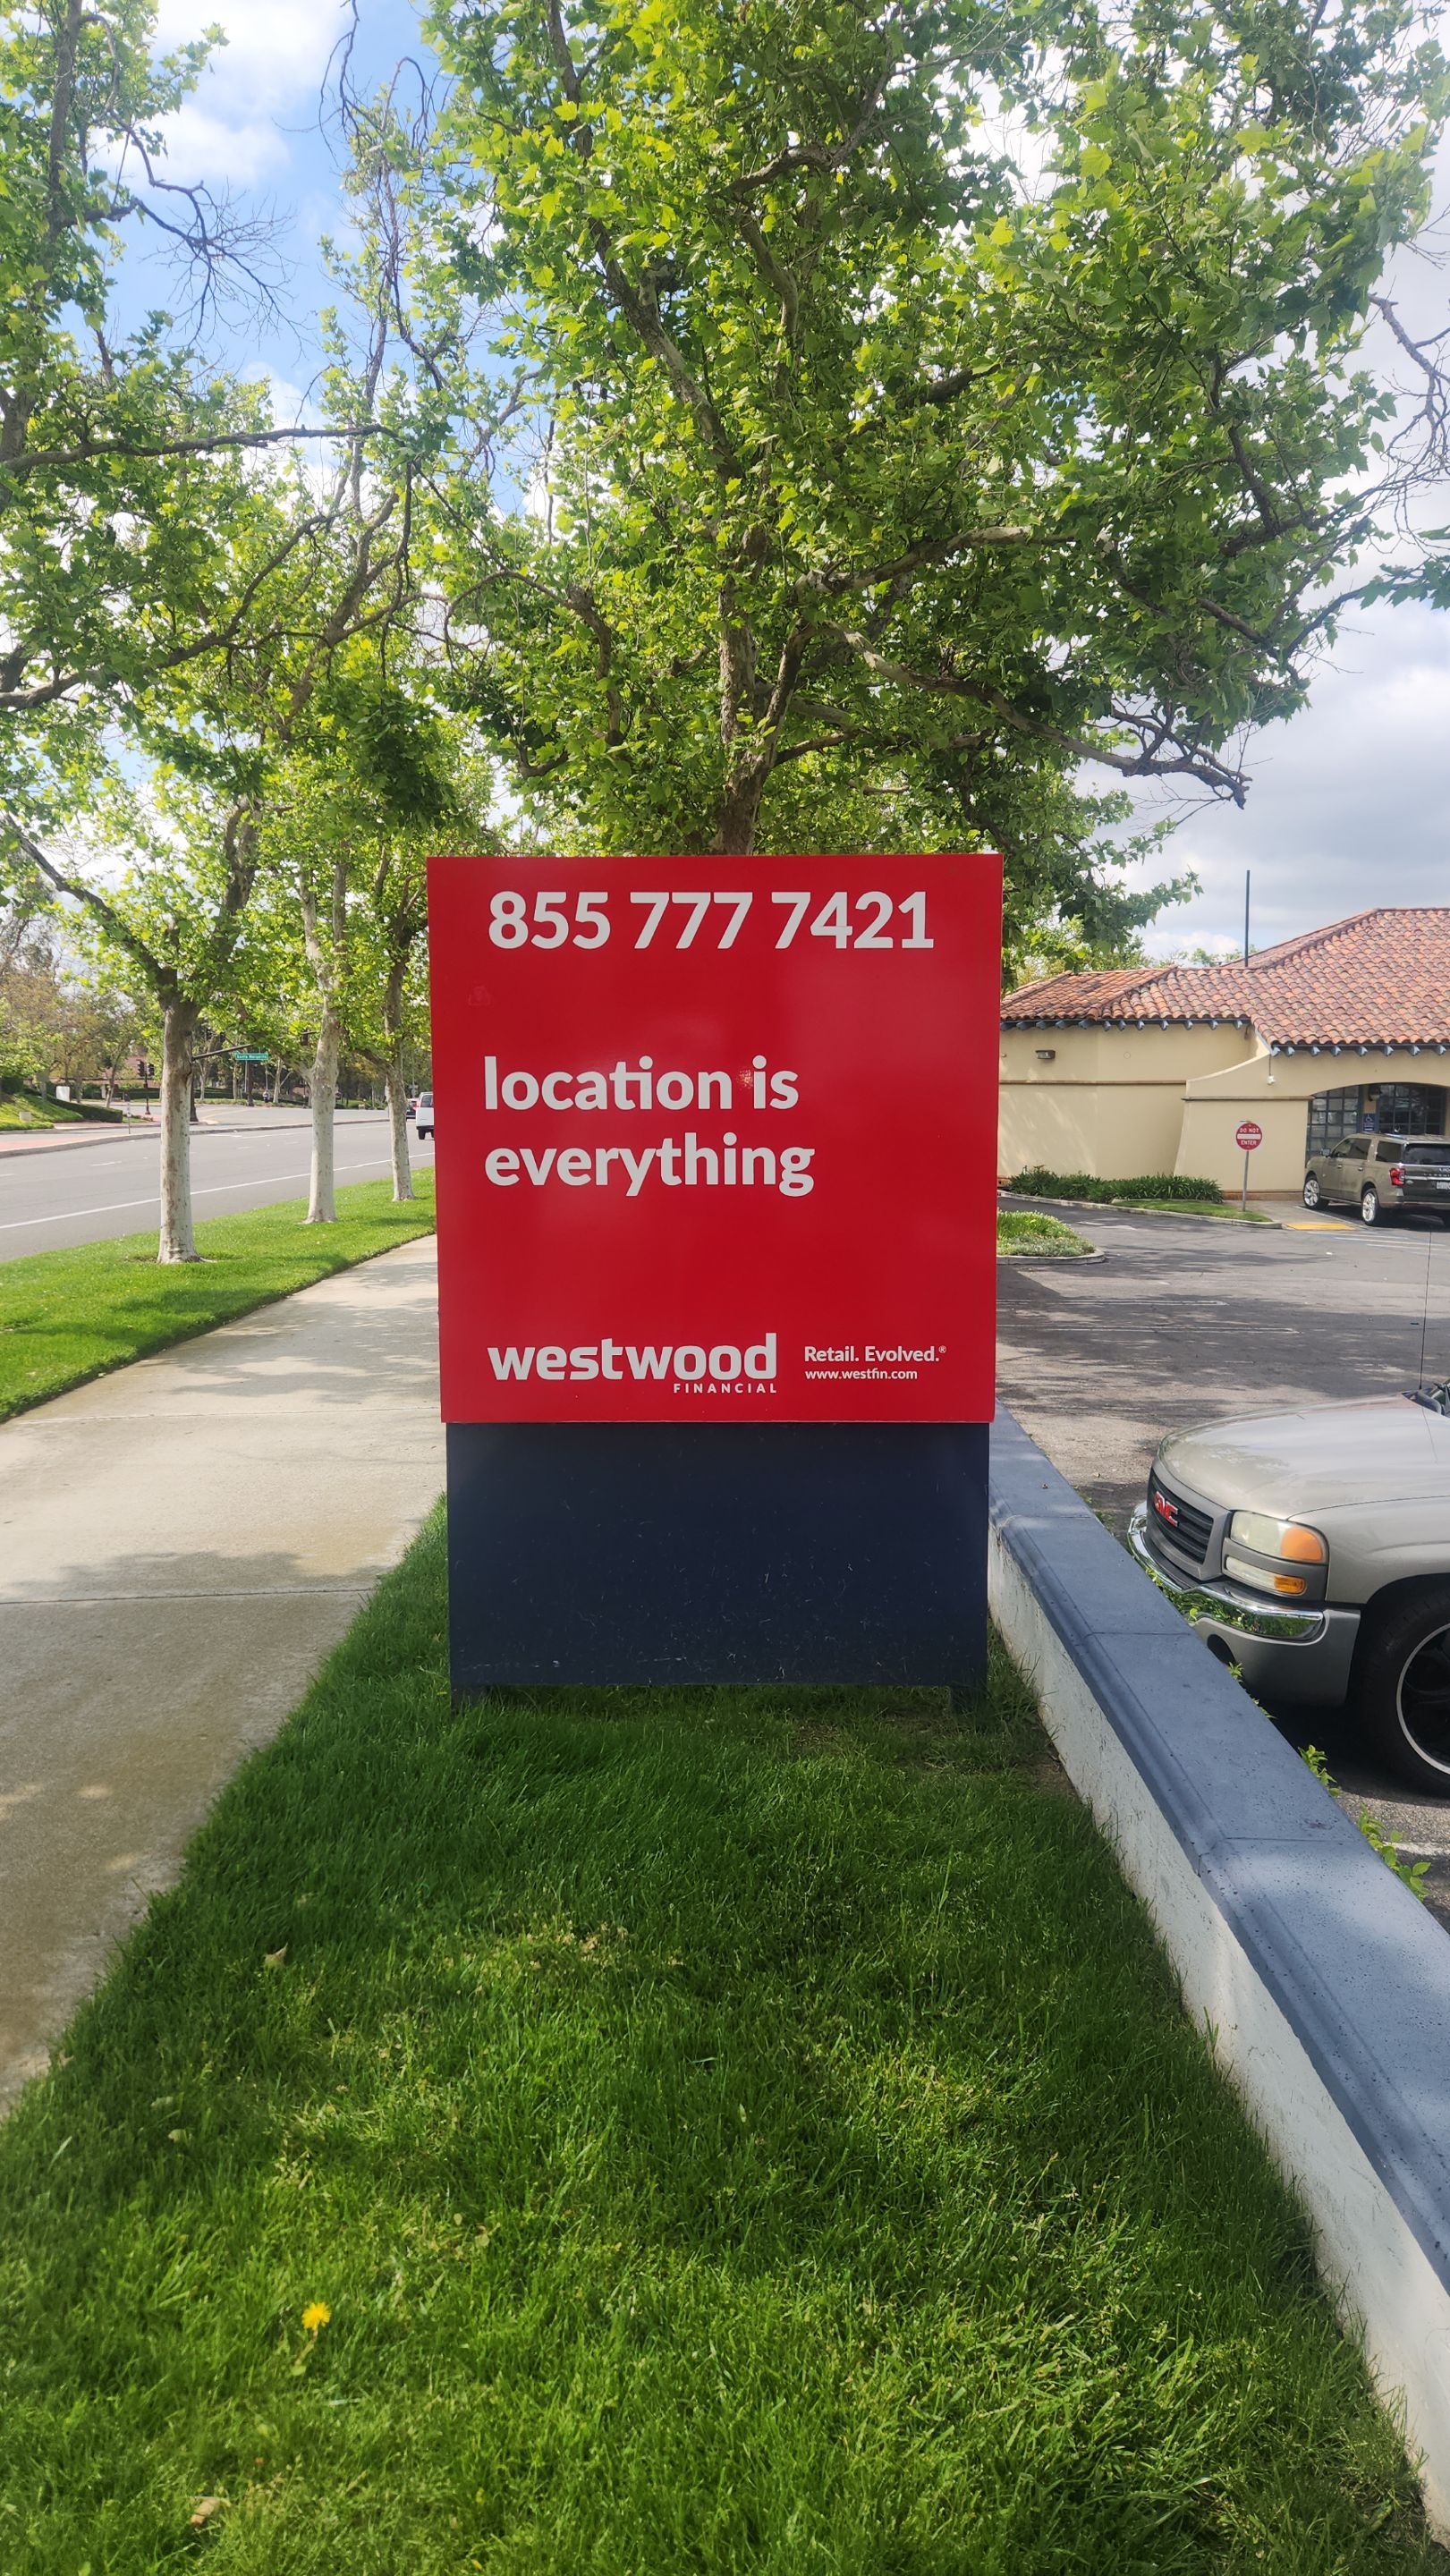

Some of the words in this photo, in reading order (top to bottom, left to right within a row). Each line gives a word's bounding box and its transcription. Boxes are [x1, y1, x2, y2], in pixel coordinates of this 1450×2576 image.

[488, 891, 611, 950] 855
[630, 891, 753, 950] 777
[772, 891, 935, 950] 7421
[484, 1055, 732, 1110] location
[753, 1055, 799, 1110] is
[484, 1131, 815, 1197] everything
[488, 1332, 777, 1380] westwood
[804, 1345, 860, 1362] Retail.
[805, 1368, 918, 1380] www.westfin.com
[673, 1382, 777, 1394] FINANCIAL
[1154, 1490, 1179, 1528] GMC
